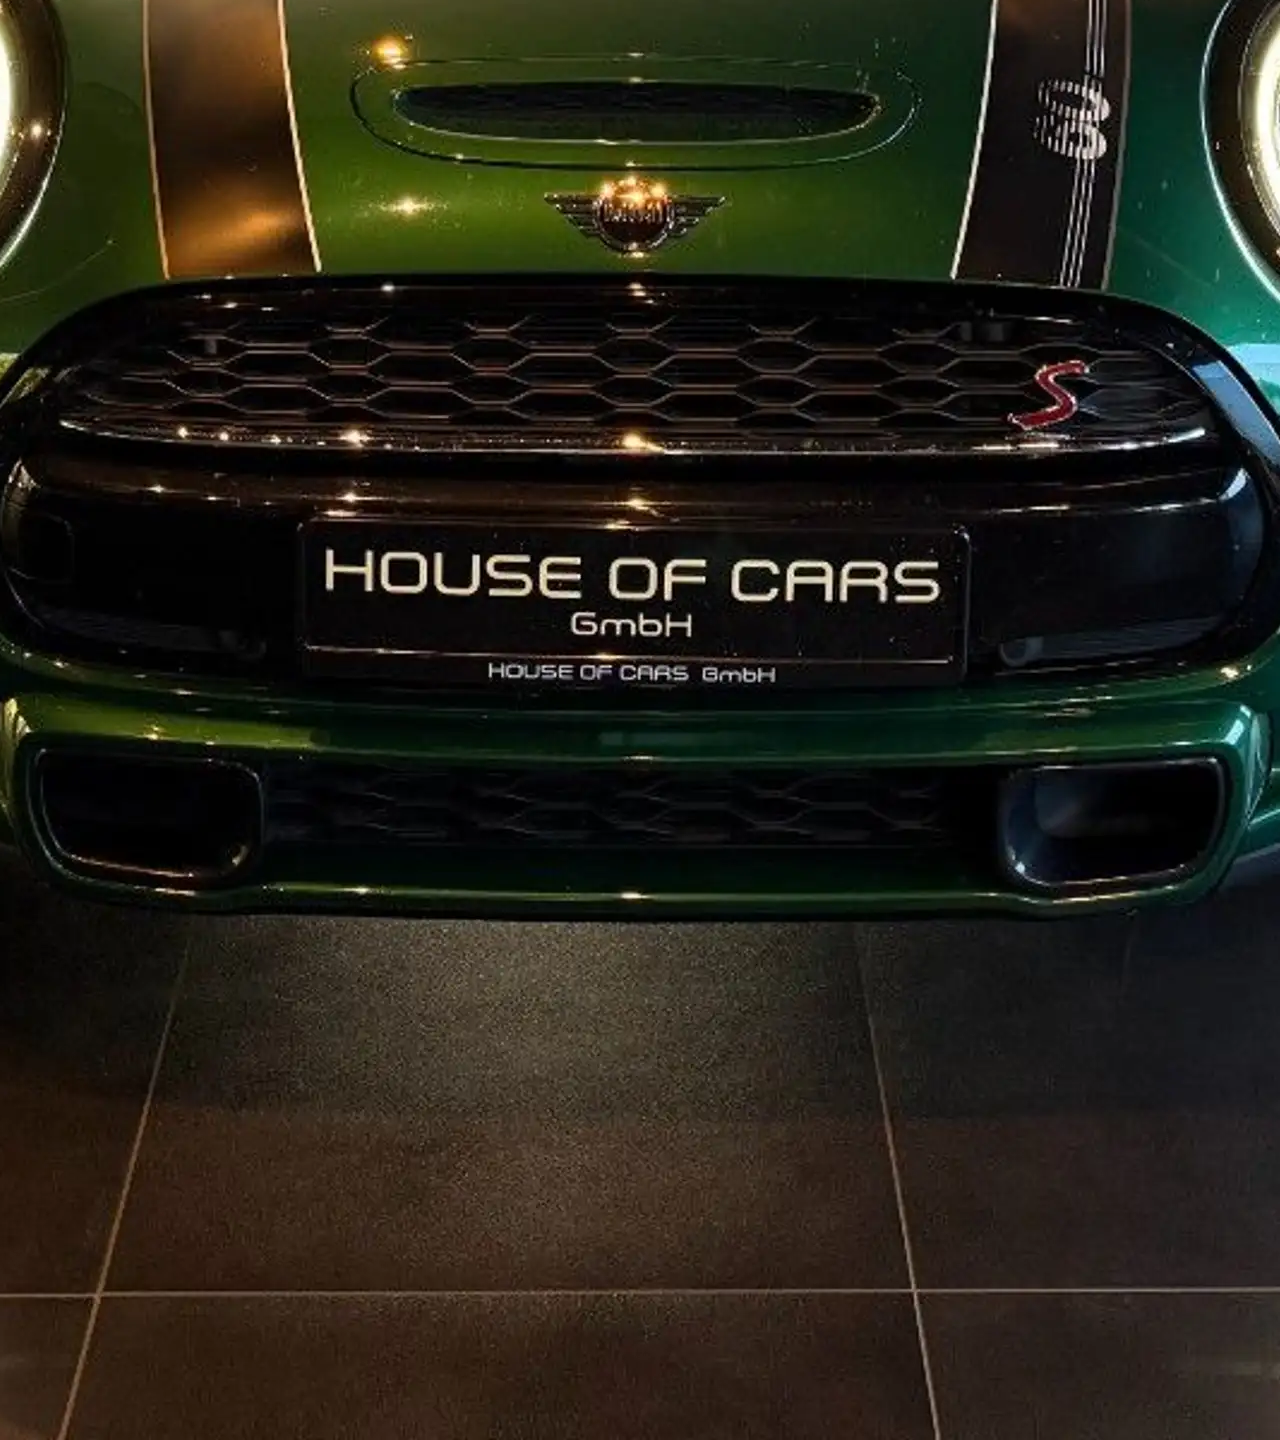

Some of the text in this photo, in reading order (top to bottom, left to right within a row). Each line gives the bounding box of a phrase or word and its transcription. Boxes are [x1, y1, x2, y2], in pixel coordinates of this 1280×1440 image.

[1006, 359, 1090, 431] S
[324, 548, 941, 604] HOUSE OF CARS
[570, 611, 693, 638] GmbH
[487, 662, 777, 684] HOUSE OF CARS GmbH
